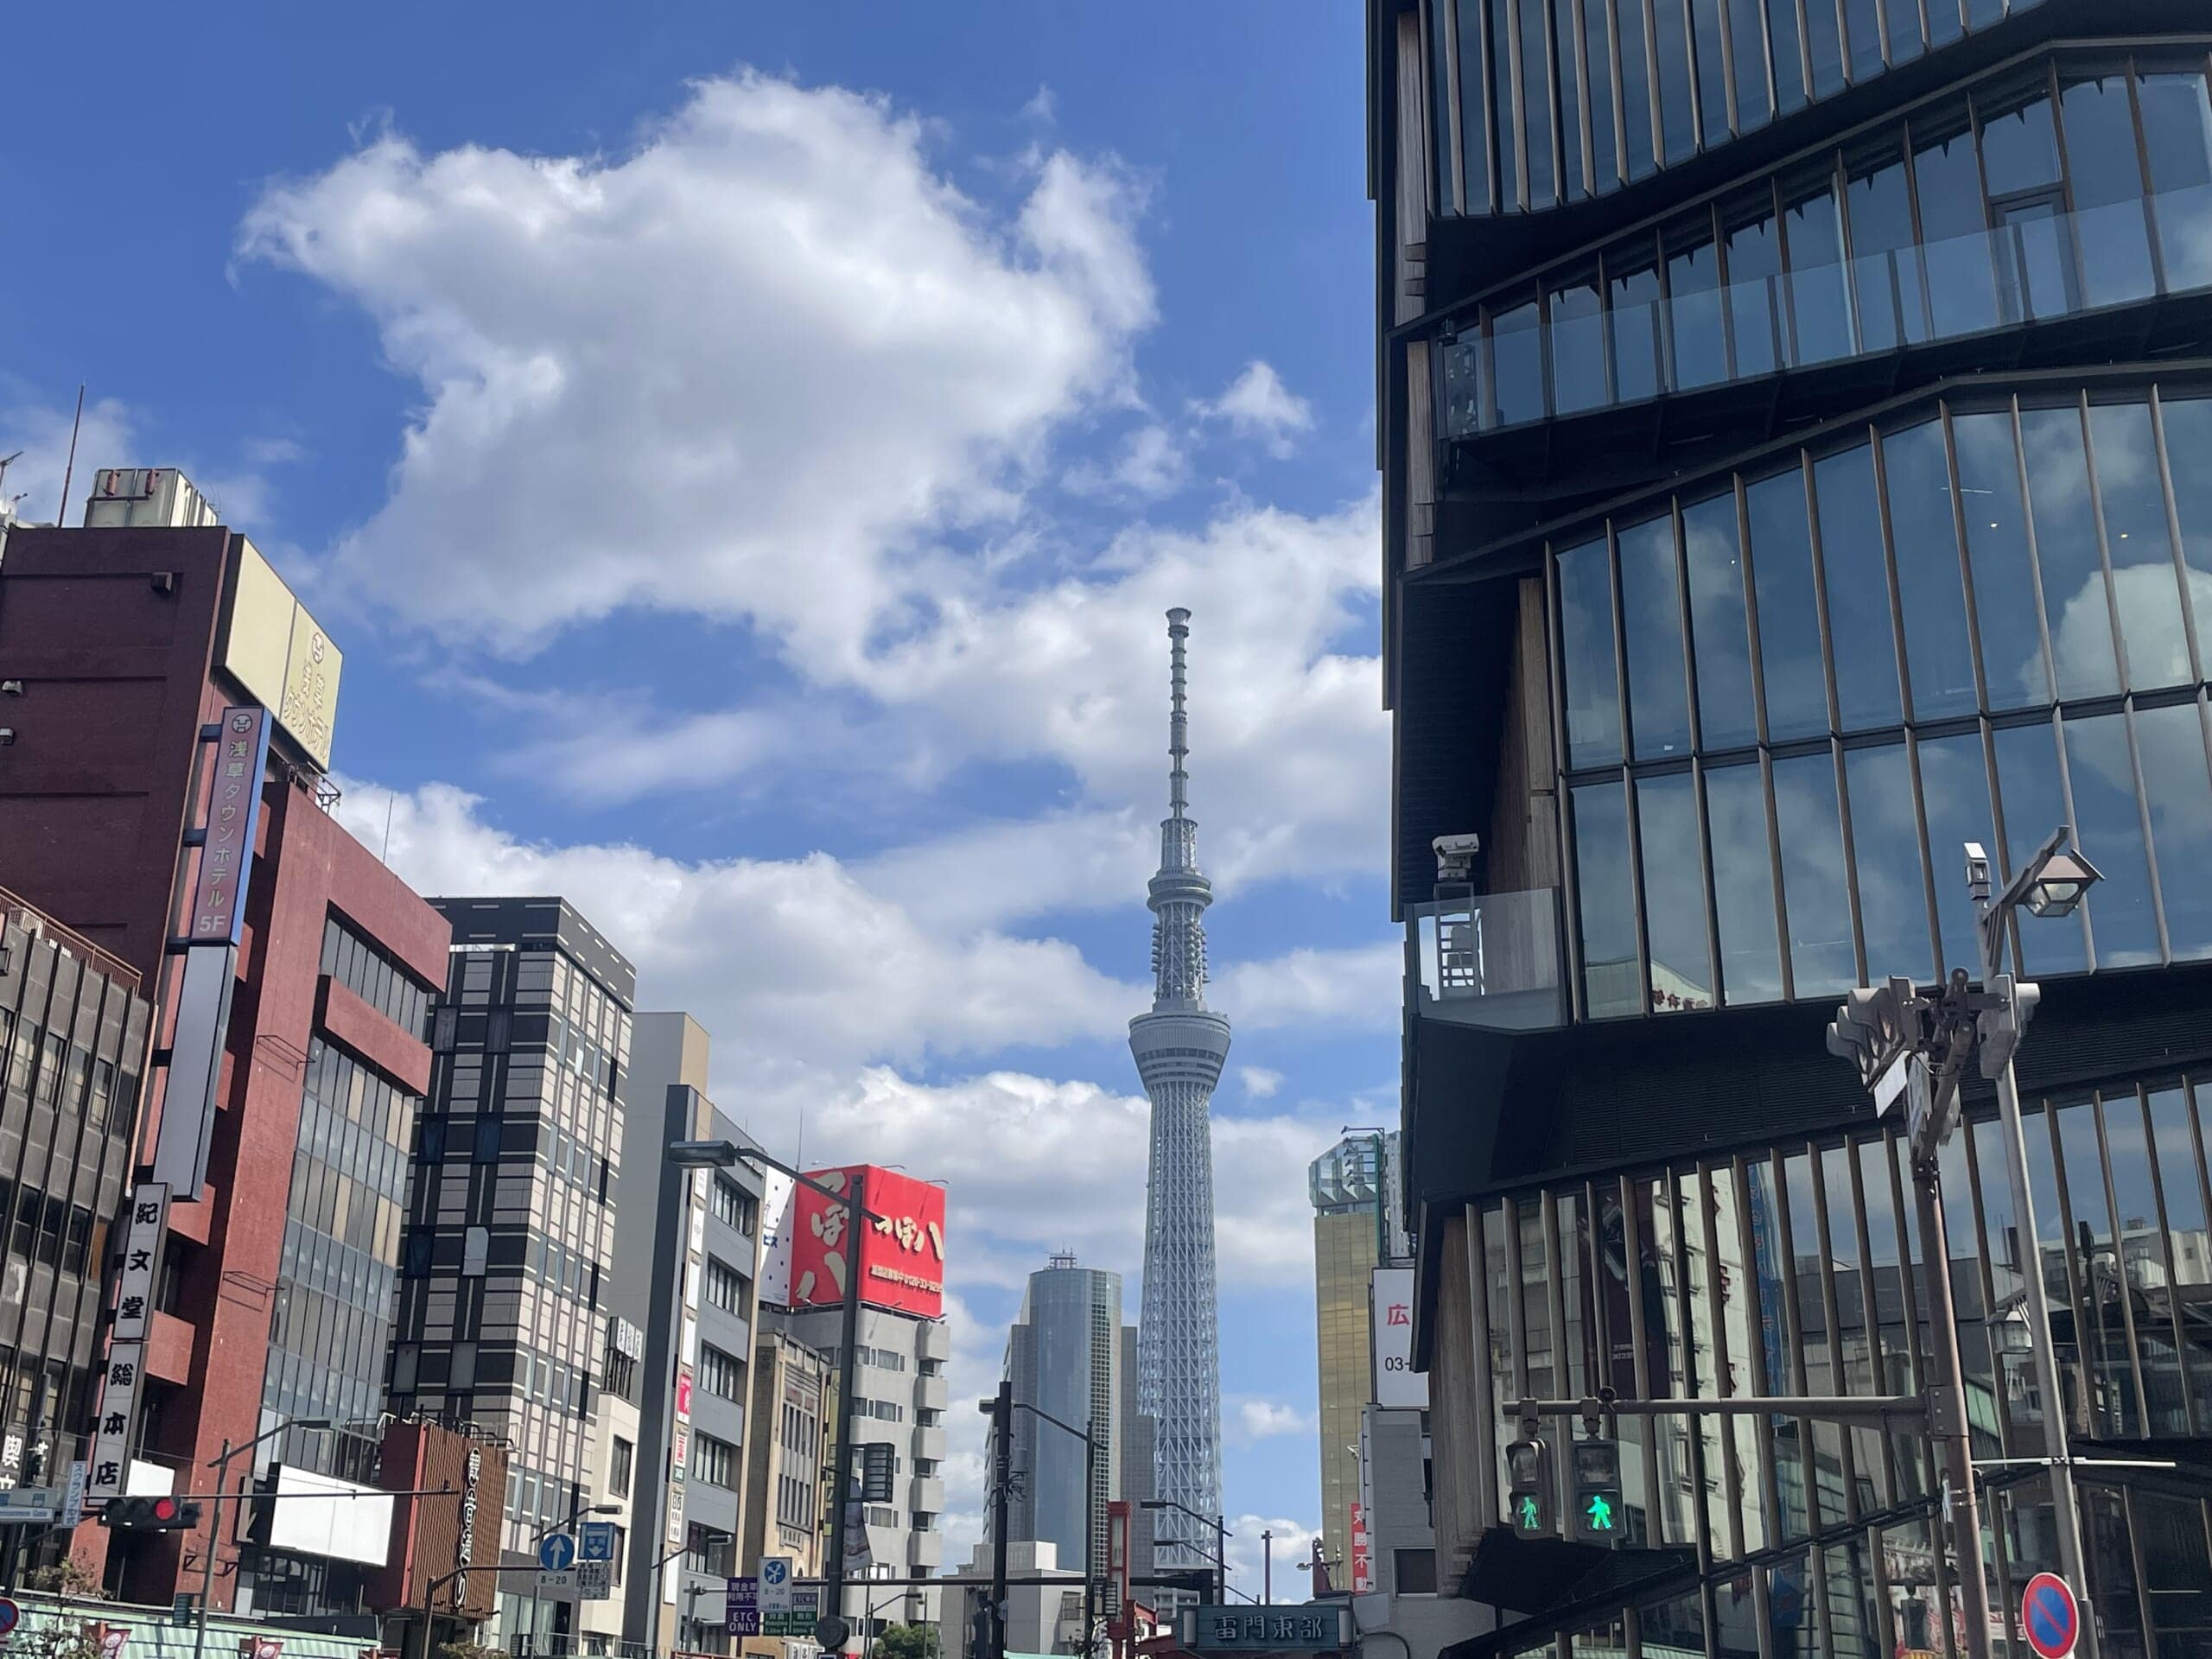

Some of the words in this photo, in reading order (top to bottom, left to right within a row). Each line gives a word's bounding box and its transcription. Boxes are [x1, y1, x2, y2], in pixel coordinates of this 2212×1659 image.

[207, 741, 249, 907] 浅草タウンホテル
[199, 915, 226, 932] 5F
[874, 1215, 945, 1262] つぼ八
[1388, 1304, 1410, 1325] 広
[95, 1202, 159, 1486] 紀文堂総本店
[728, 1622, 757, 1632] ONLY
[733, 1611, 753, 1622] ETC
[1215, 1615, 1322, 1640] 雷門東部
